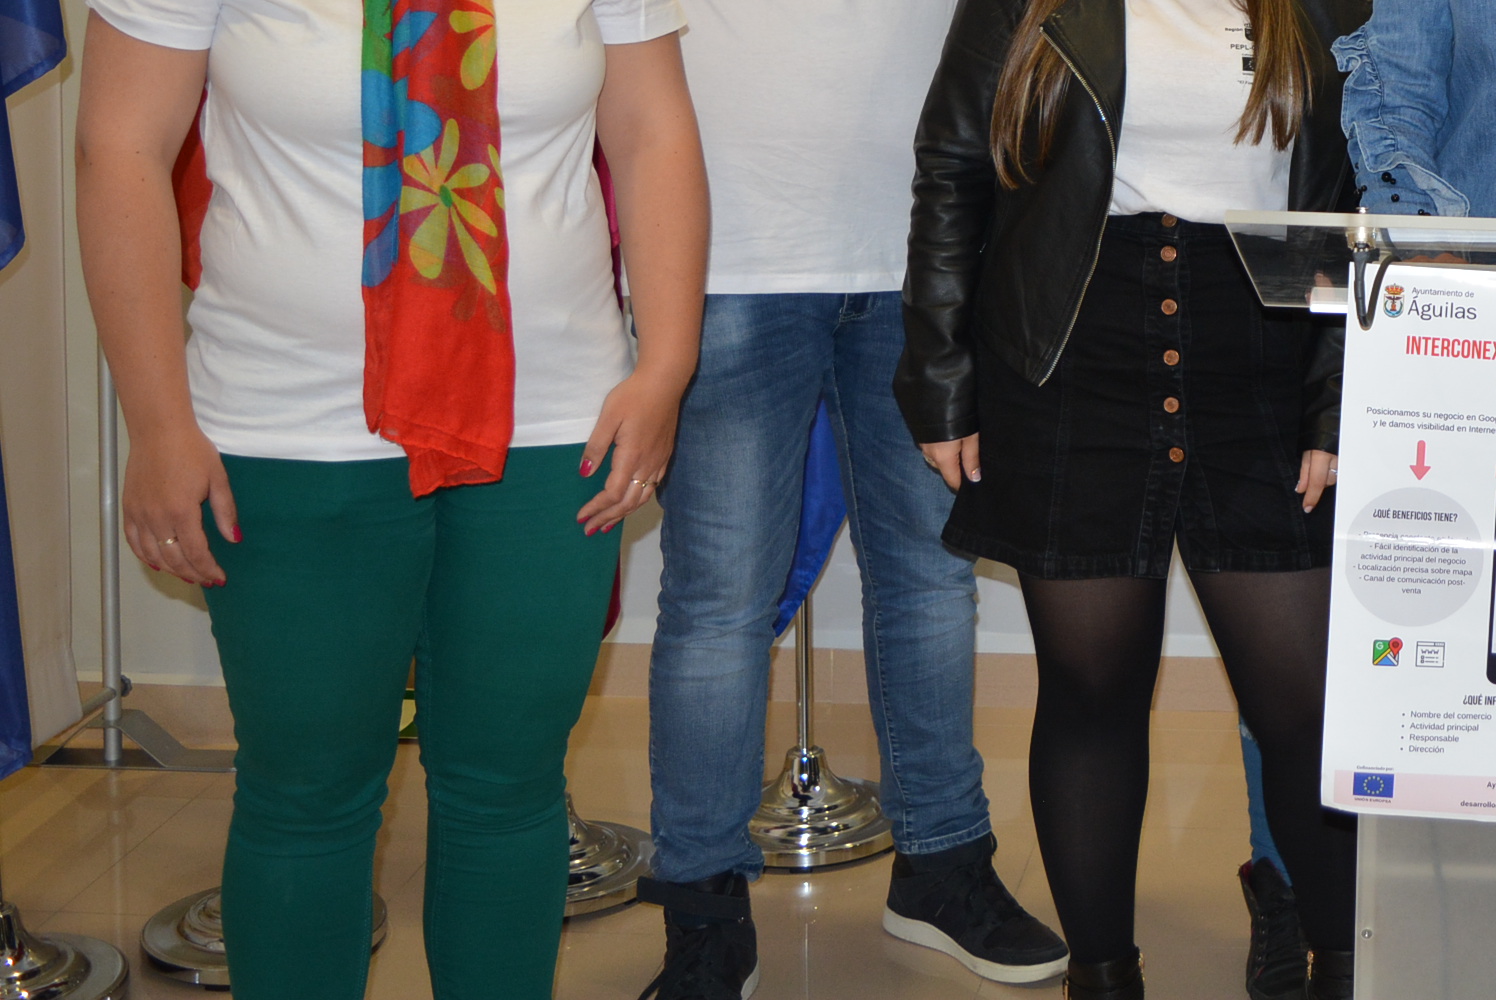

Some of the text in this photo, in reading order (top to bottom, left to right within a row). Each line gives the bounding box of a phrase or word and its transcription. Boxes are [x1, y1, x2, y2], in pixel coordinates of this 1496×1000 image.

[1412, 287, 1463, 297] Ayuntamiento
[1408, 296, 1477, 320] Águilas
[1367, 407, 1420, 418] Posicionamos
[1434, 412, 1464, 421] negocio
[1372, 420, 1378, 428] y
[1389, 420, 1415, 429] damos
[1418, 422, 1454, 431] visibilidad
[1373, 508, 1458, 522] ¿QUÉ BENEFICIOS TIENE?
[1393, 544, 1439, 553] identificación
[1361, 553, 1392, 561] actividad
[1394, 555, 1424, 563] principal
[1358, 564, 1401, 572] Localización
[1463, 694, 1483, 705] ¿QUÉ
[1410, 711, 1441, 719] Nombre
[1409, 722, 1479, 732] Actividad principal
[1409, 734, 1459, 742] Responsable
[1409, 745, 1445, 753] Dirección
